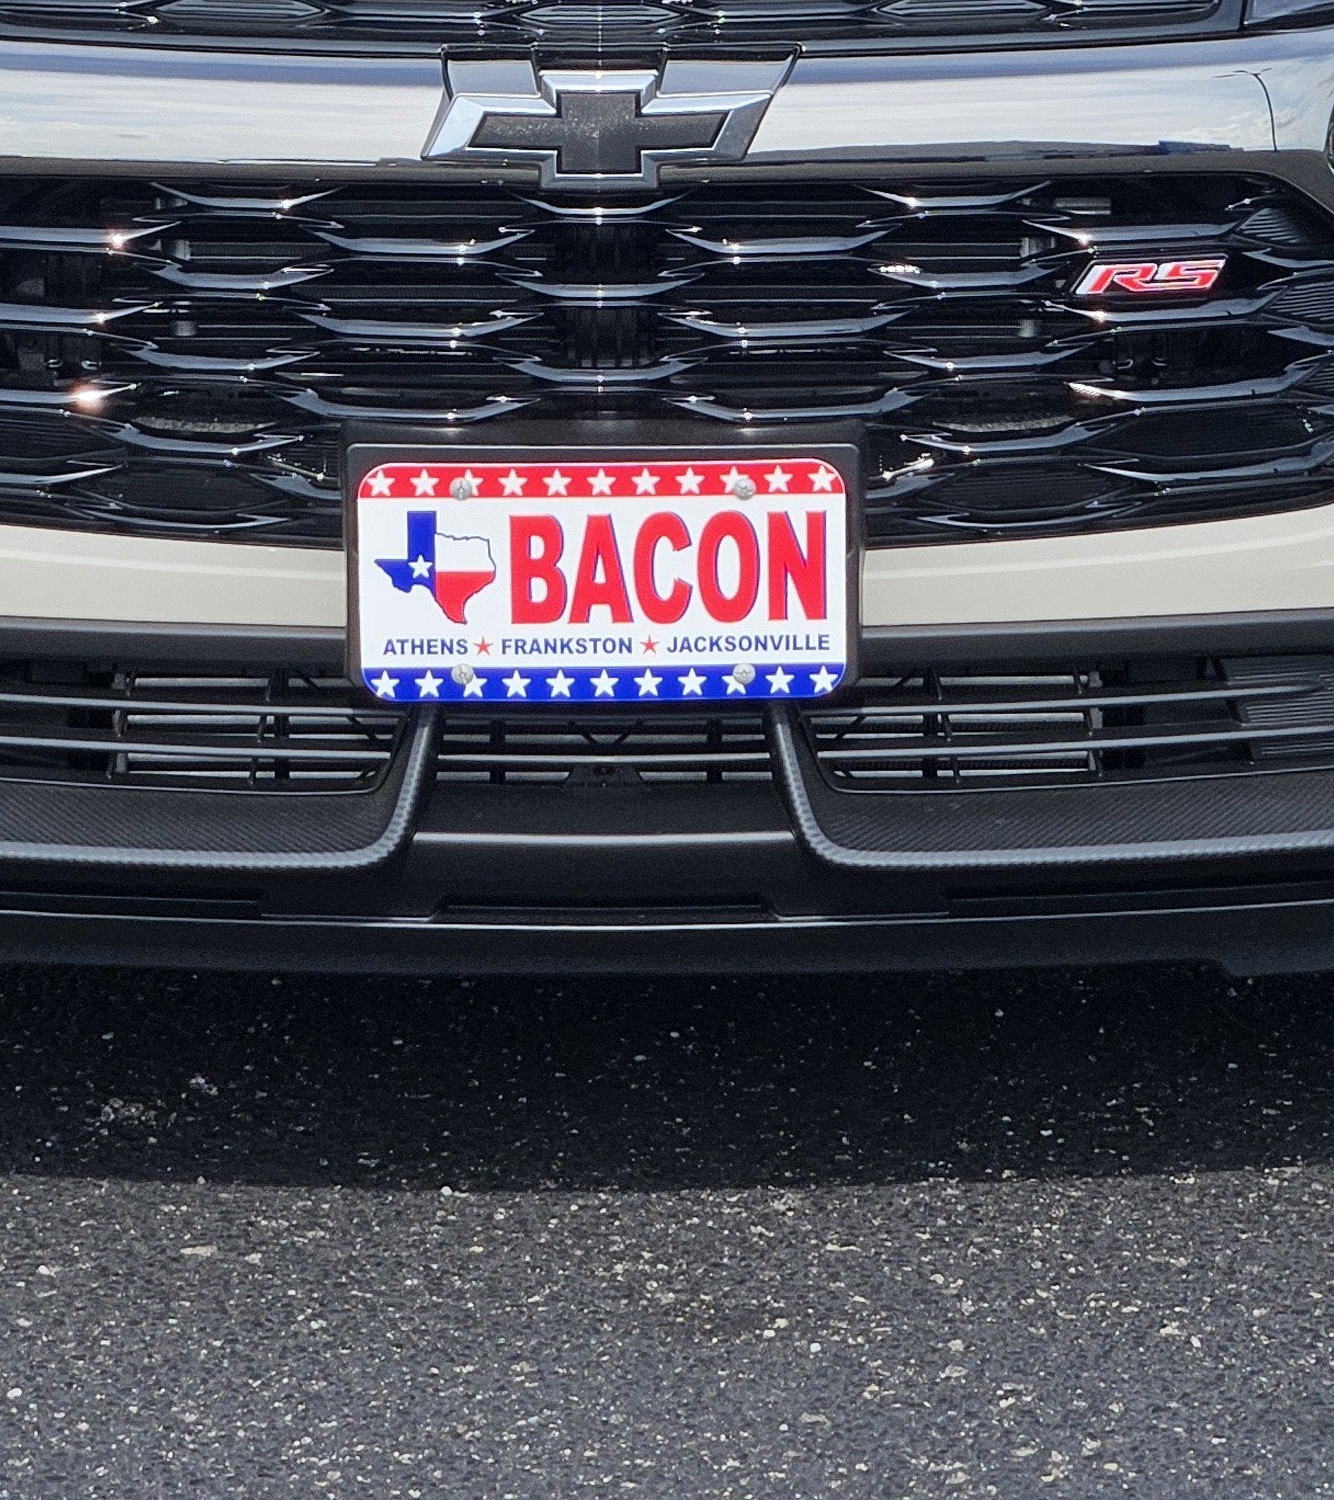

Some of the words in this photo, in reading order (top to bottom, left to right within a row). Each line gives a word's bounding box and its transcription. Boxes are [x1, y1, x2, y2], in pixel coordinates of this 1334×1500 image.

[1075, 259, 1226, 295] RS
[509, 510, 828, 625] BACON
[382, 636, 469, 656] ATHENS
[501, 636, 633, 655] FRANKSTON
[666, 633, 831, 654] JACKSONVILLE
